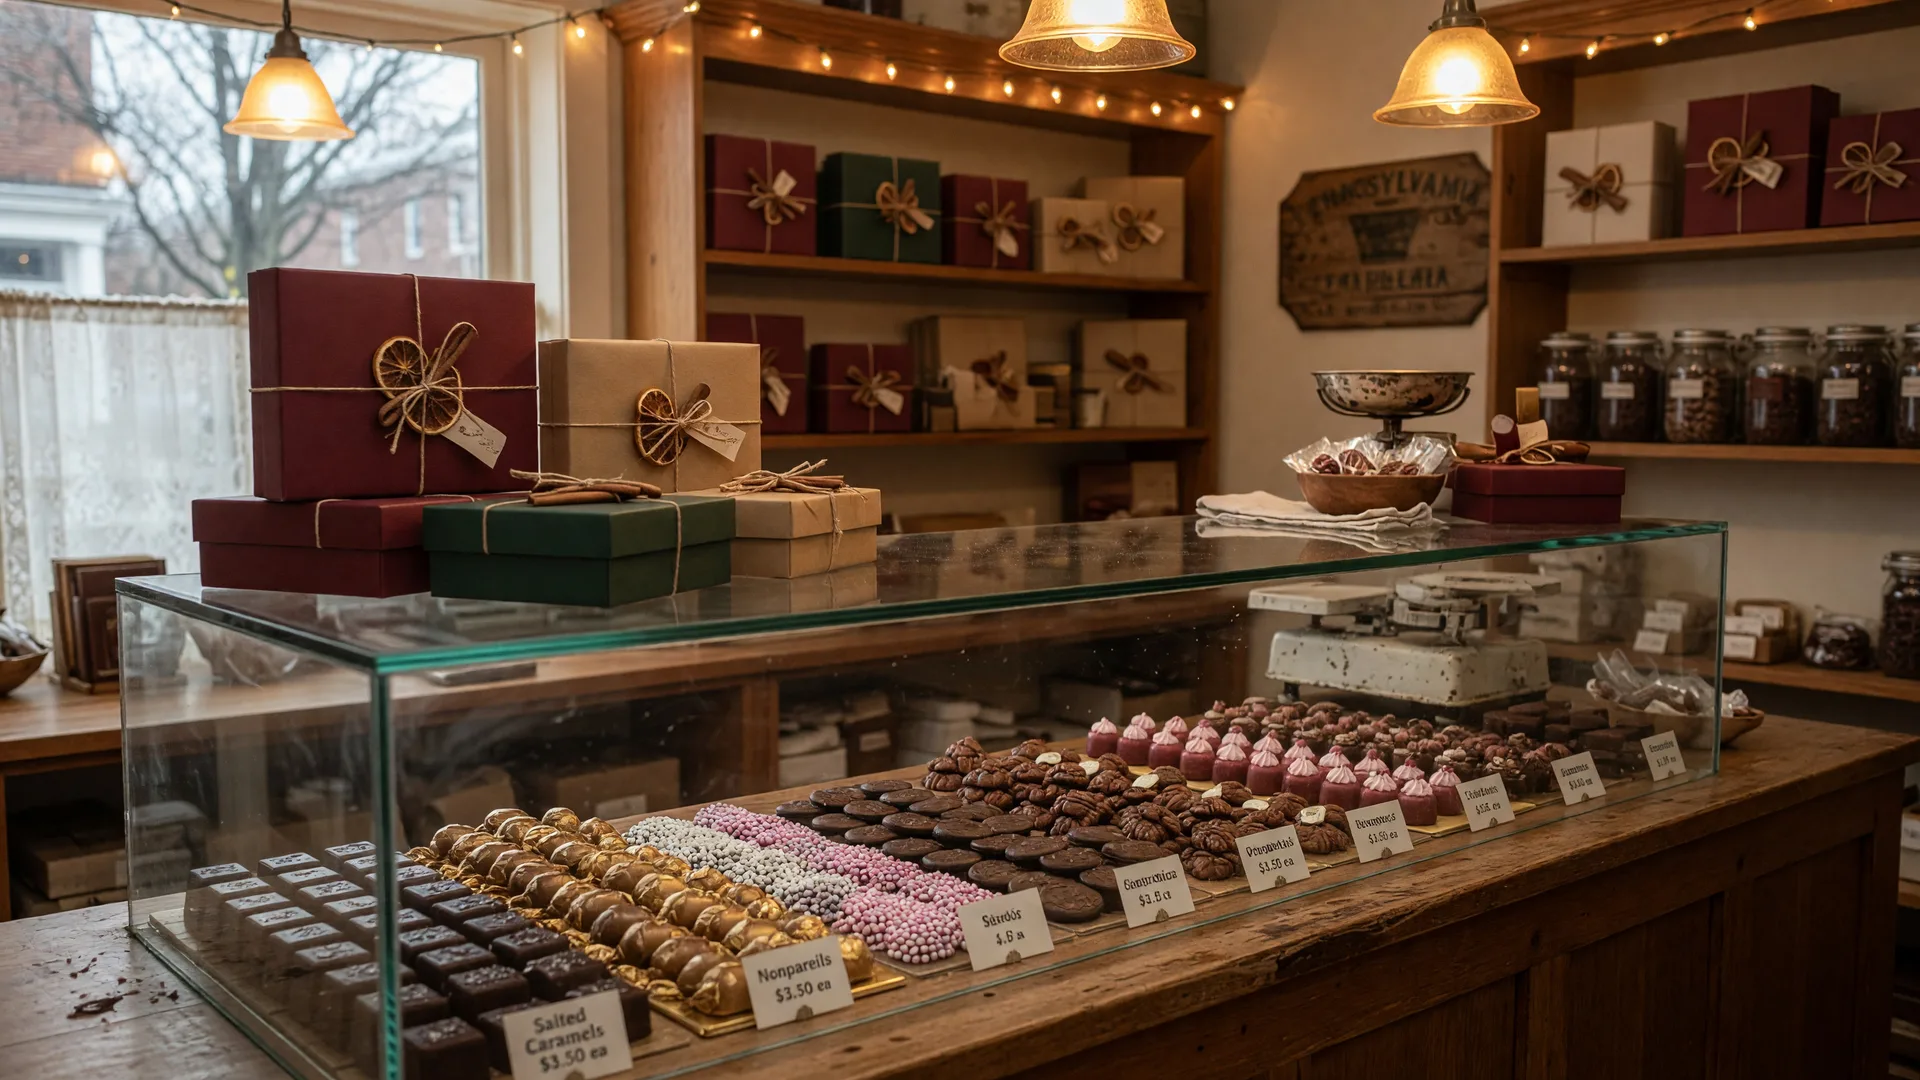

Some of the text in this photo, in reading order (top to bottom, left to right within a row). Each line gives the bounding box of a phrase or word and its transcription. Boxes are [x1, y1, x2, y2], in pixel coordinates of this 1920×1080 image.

[1390, 831, 1398, 839] ea
[1284, 857, 1294, 867] ea
[757, 952, 832, 983] Nonpareils
[775, 980, 832, 1004] $3.50 ea
[533, 1006, 587, 1034] Salted
[525, 1023, 605, 1055] Caramels
[540, 1045, 608, 1073] $3.50 ea
